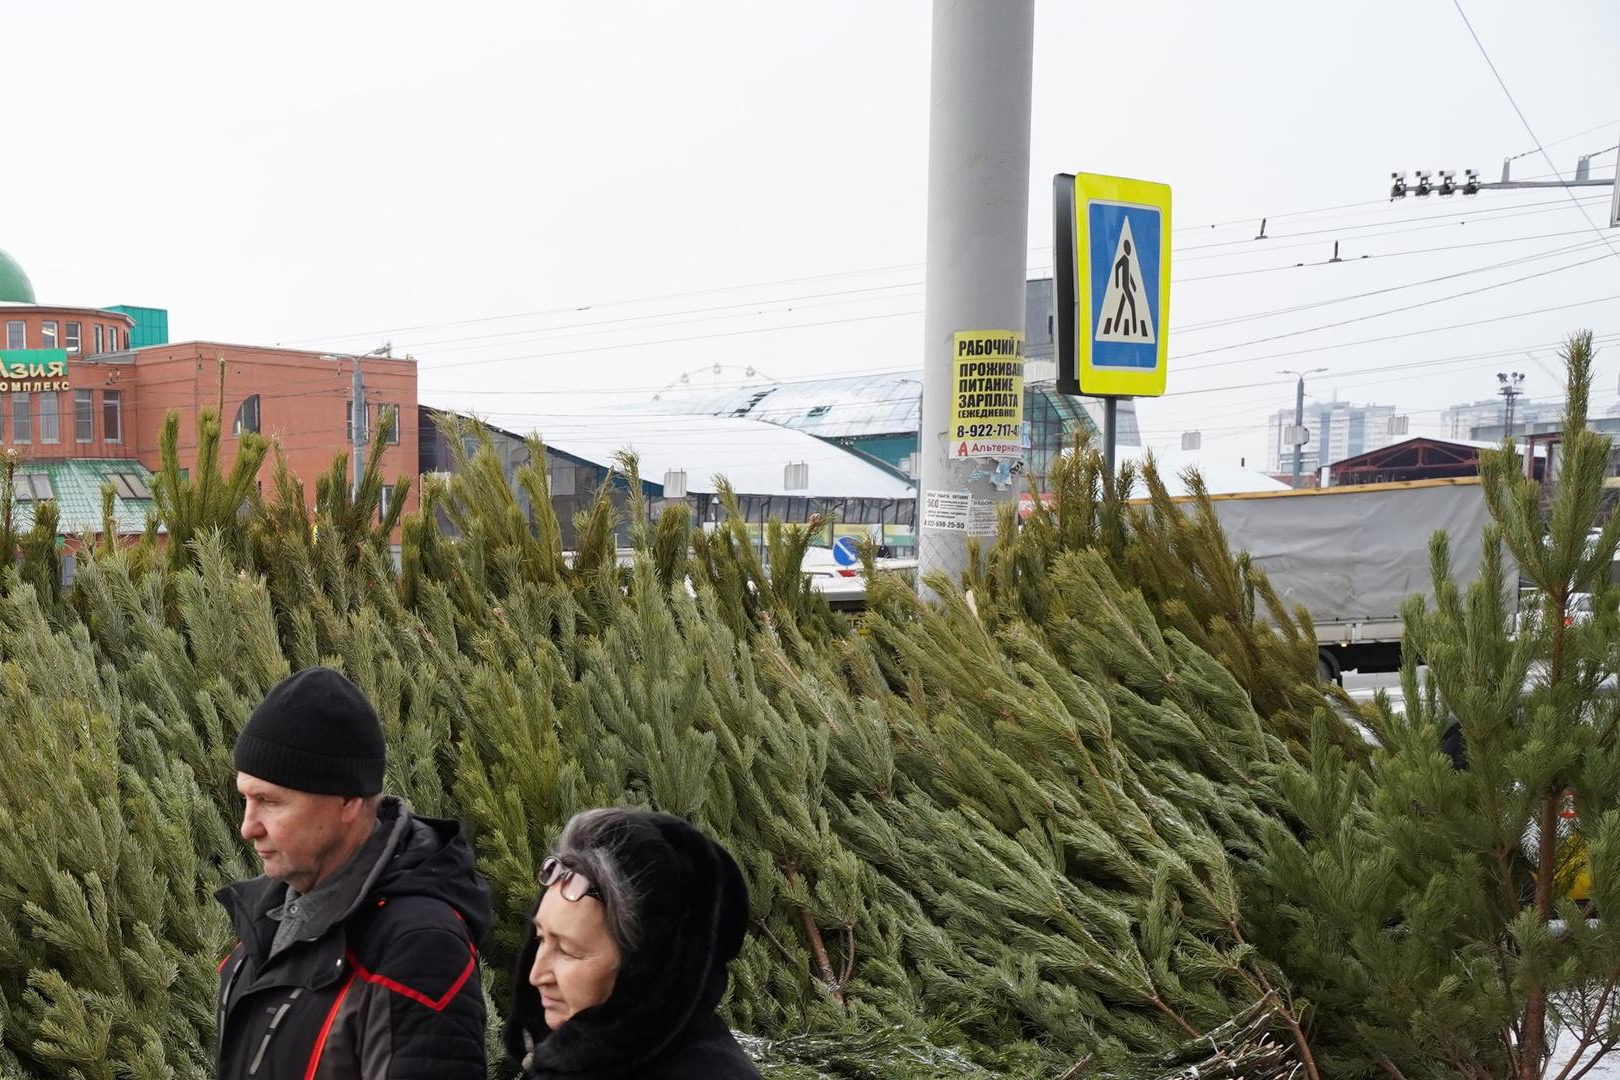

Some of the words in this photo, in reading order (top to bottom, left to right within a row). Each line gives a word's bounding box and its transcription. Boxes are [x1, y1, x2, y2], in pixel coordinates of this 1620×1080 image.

[958, 336, 1015, 356] РАБОЧИЙ
[958, 378, 1014, 393] ПИТАНИЕ
[958, 393, 1019, 408] ЗАРПЛАТА
[958, 408, 1016, 419] (ЕЖЕДНЕВНО)
